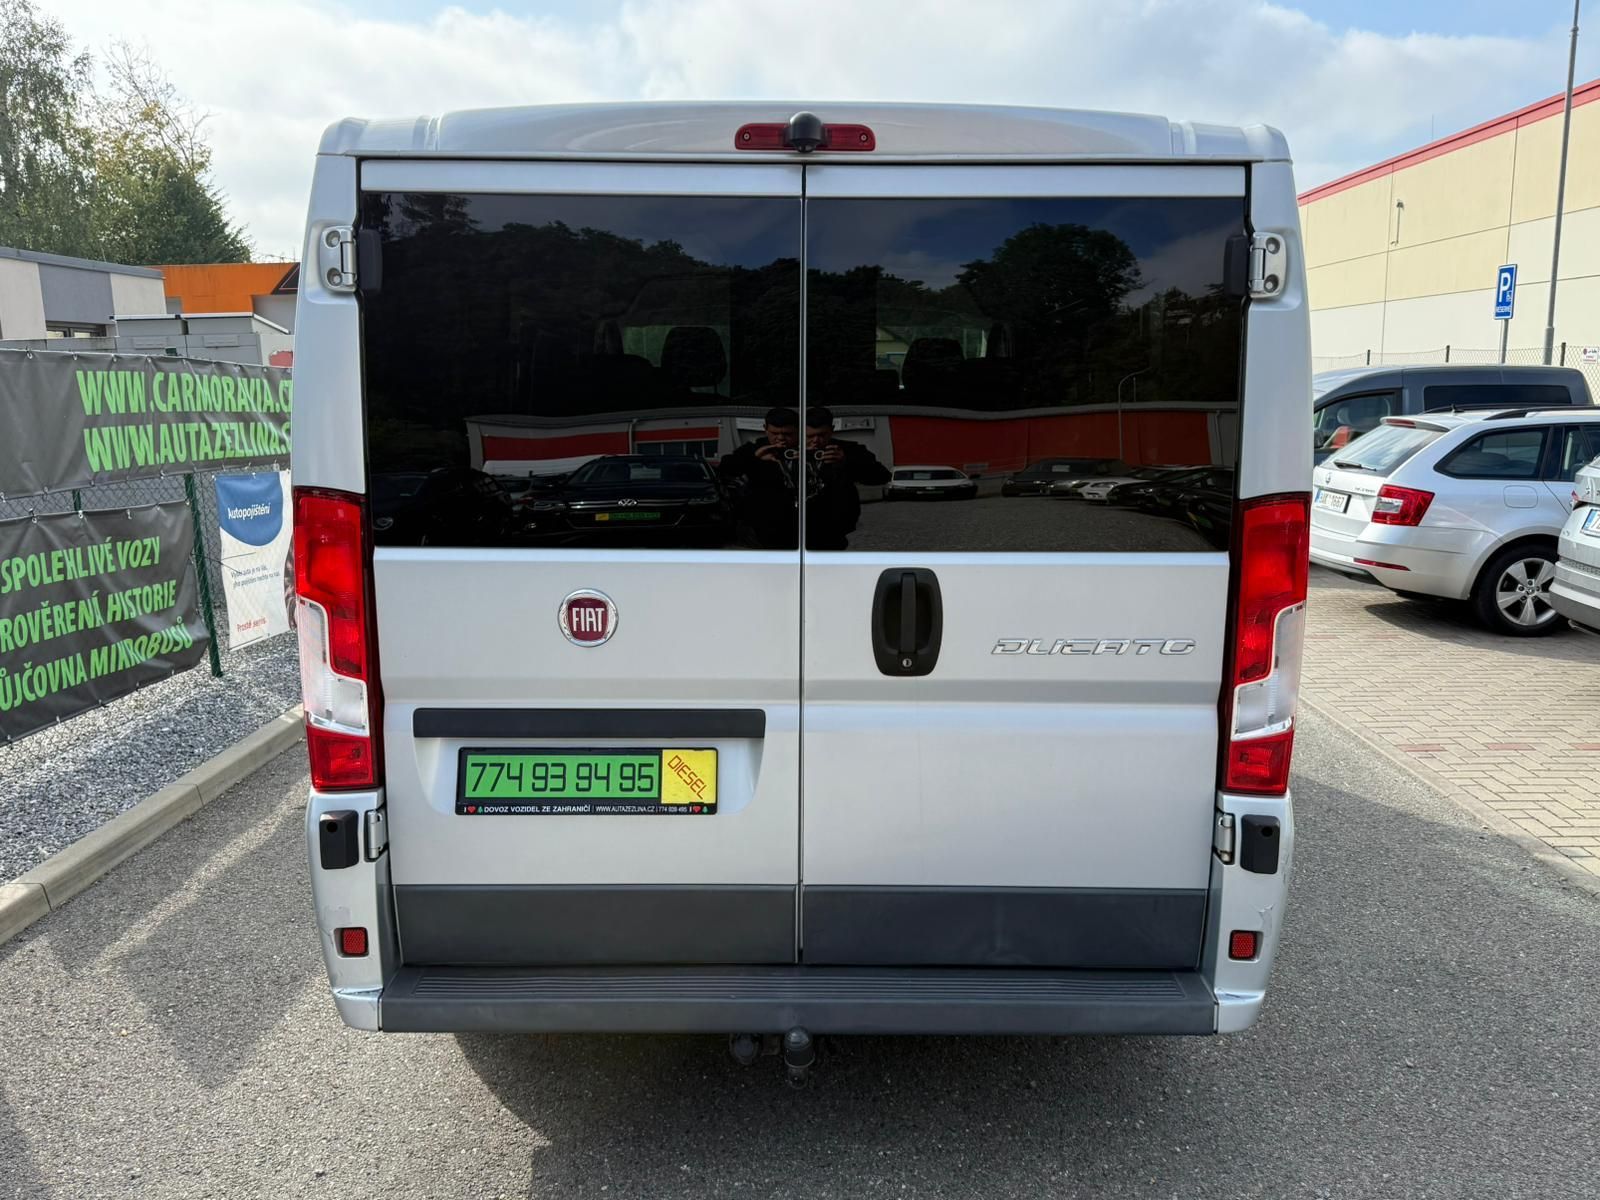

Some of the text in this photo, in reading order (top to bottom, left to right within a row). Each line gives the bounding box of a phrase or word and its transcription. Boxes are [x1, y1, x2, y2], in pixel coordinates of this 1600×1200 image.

[1498, 272, 1511, 303] P
[227, 502, 271, 521] Autopojištění
[0, 536, 161, 594] SPOLEHLIVÉ VOZY
[107, 579, 177, 624] HISTORIE
[572, 607, 605, 632] FIAT
[90, 616, 193, 680] MIKROBUSŮ
[991, 638, 1196, 655] DUCATO
[471, 762, 655, 792] 774 93 94 95
[667, 754, 707, 800] DIESEL
[510, 805, 540, 813] VOZIDEL
[541, 805, 551, 813] ZE
[552, 804, 591, 813] ZAHRANIČÍ
